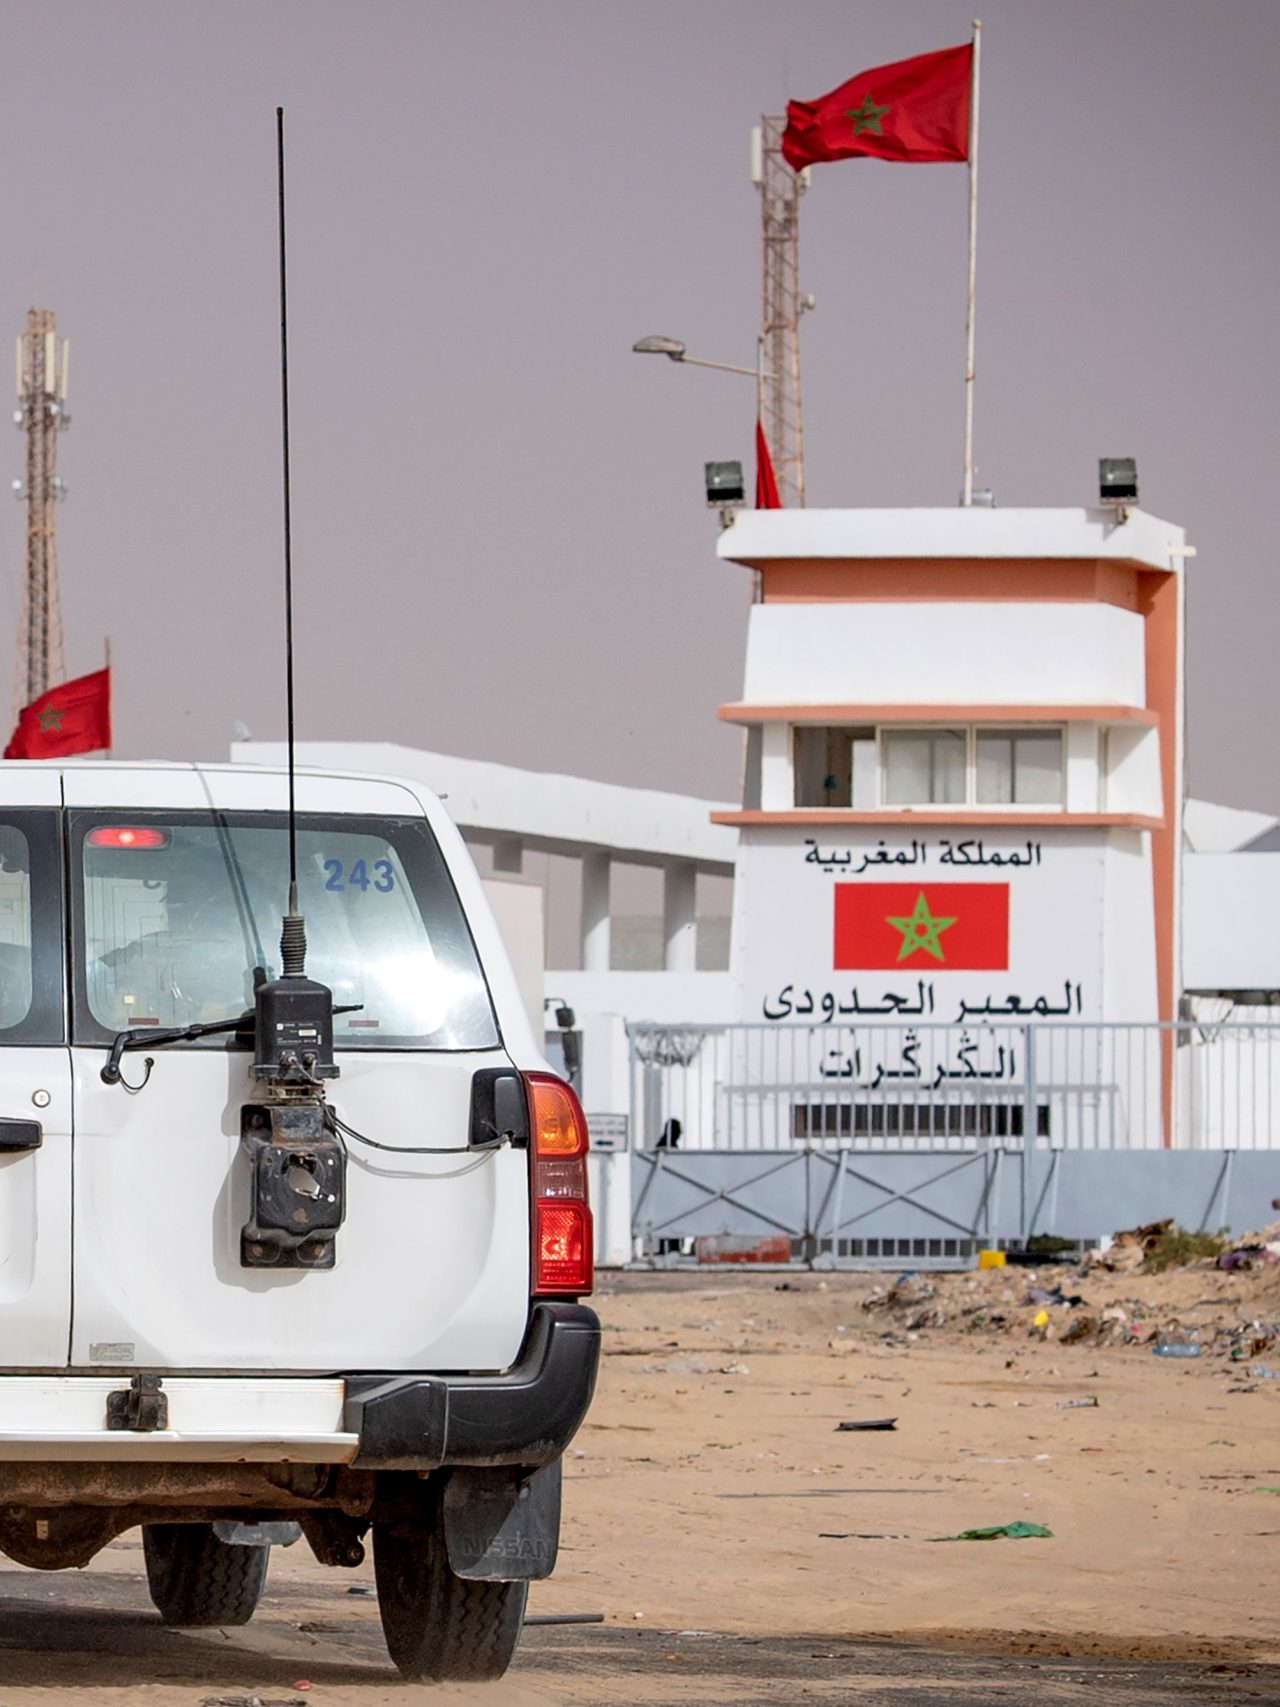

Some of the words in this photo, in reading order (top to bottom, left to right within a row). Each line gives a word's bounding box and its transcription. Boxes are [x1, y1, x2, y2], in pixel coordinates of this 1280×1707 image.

[805, 839, 926, 873] المغربية
[939, 839, 1041, 866] المملكة
[324, 859, 395, 892] 243
[955, 979, 1081, 1024] المعبر
[462, 1536, 551, 1559] NISSAN
